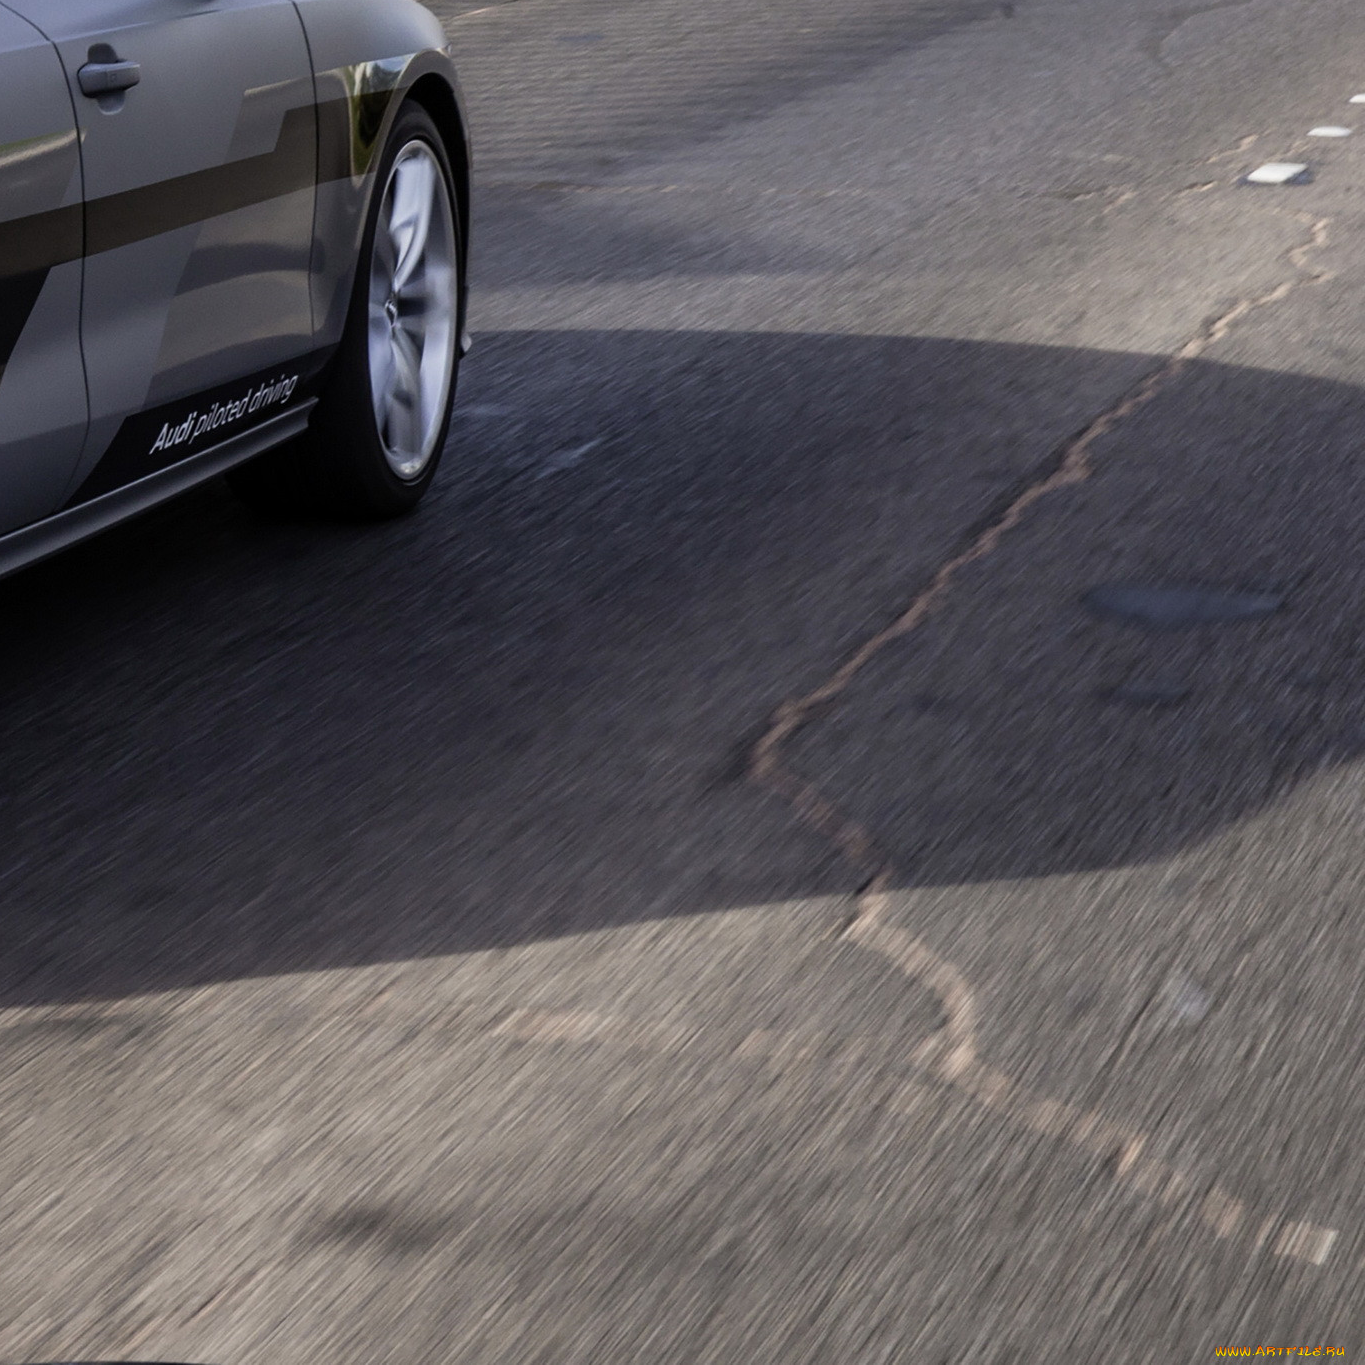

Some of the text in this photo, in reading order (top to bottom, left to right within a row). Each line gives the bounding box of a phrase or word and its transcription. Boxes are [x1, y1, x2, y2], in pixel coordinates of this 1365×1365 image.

[149, 374, 299, 455] Audi piloted driving
